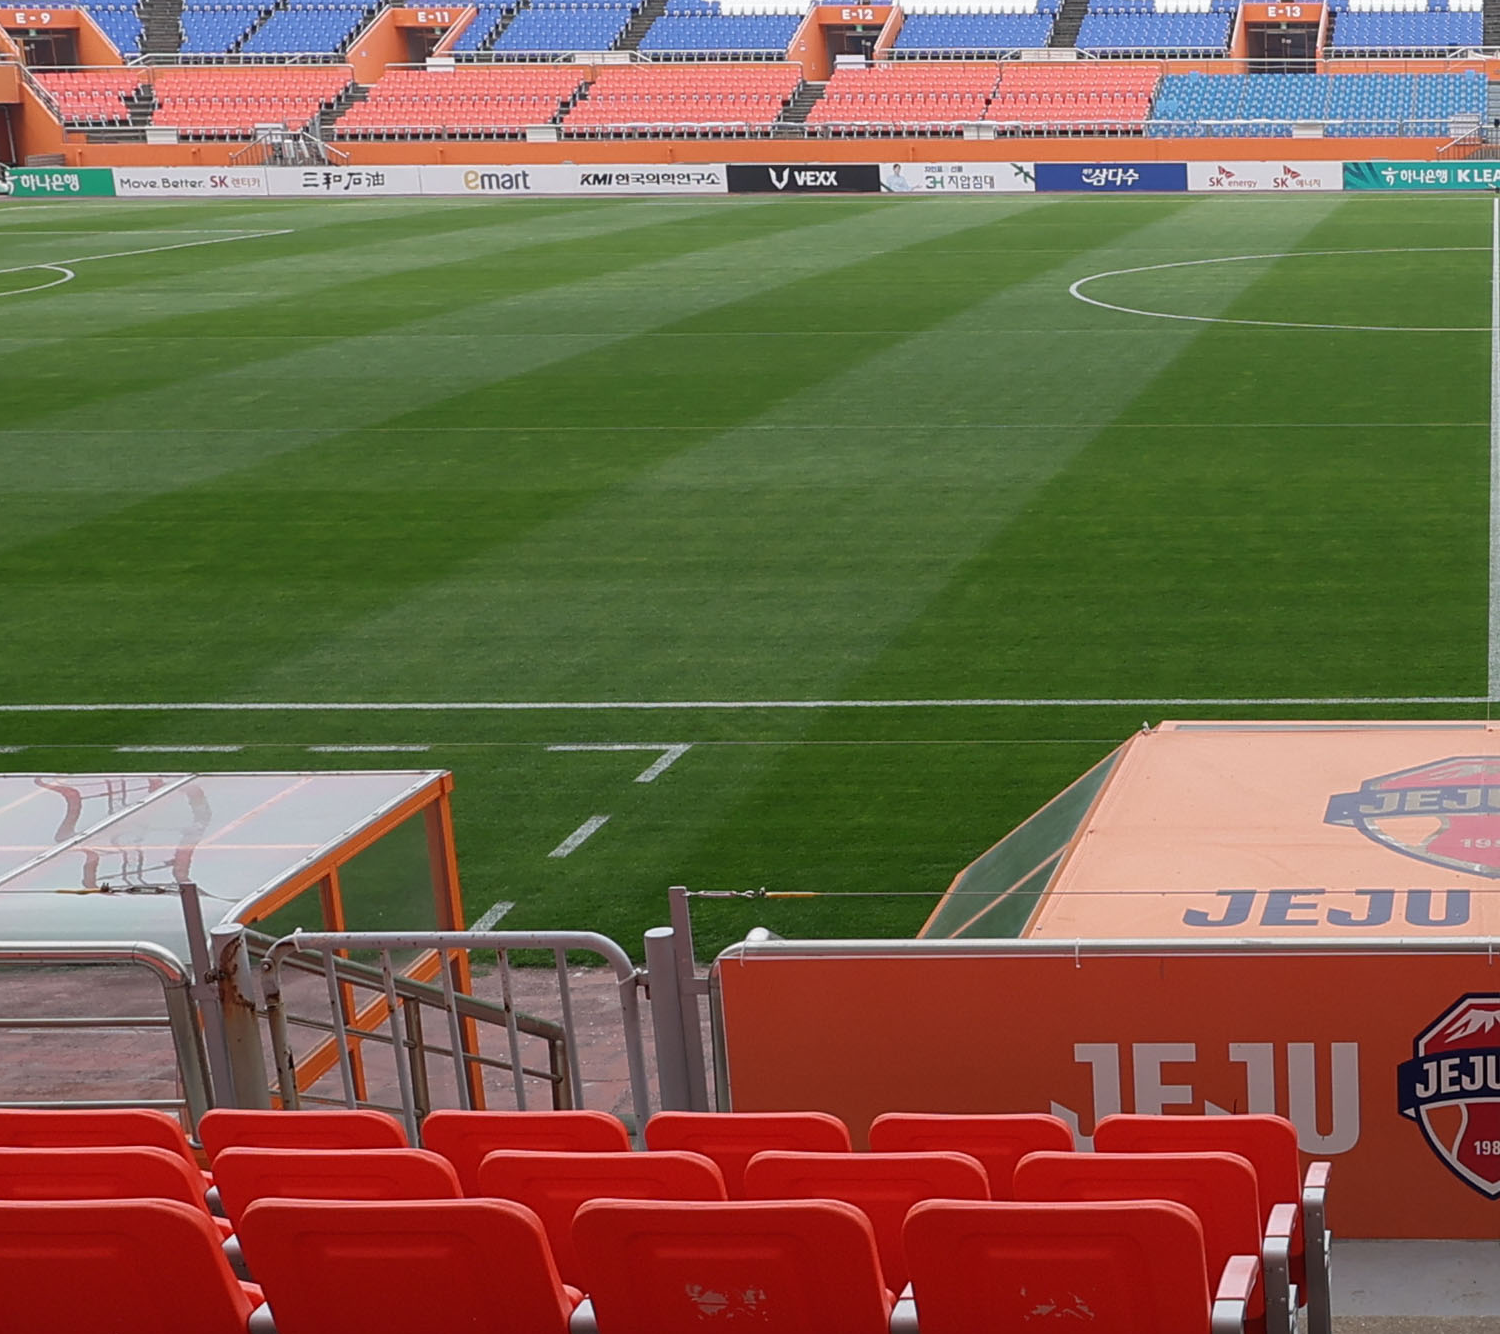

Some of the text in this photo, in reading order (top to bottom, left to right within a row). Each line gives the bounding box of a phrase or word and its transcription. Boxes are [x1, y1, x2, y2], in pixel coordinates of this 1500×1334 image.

[417, 10, 450, 24] E-11
[841, 8, 874, 21] E-12
[1267, 5, 1302, 19] E-13
[20, 172, 81, 192] 하나은행
[119, 178, 160, 189] Move.
[162, 177, 206, 189] Better.
[209, 175, 228, 189] SK
[302, 171, 386, 191] 三和石油
[463, 168, 531, 192] emart
[579, 172, 722, 186] KMI 한국의학연구소
[793, 170, 838, 186] VEXX
[1082, 167, 1140, 187] 삼다수
[1208, 175, 1258, 188] SK energy
[1273, 175, 1289, 188] SK
[1401, 168, 1448, 184] 하나은행
[1457, 169, 1471, 183] K
[1182, 887, 1478, 929] JEJU
[1051, 1042, 1361, 1156] JEJU
